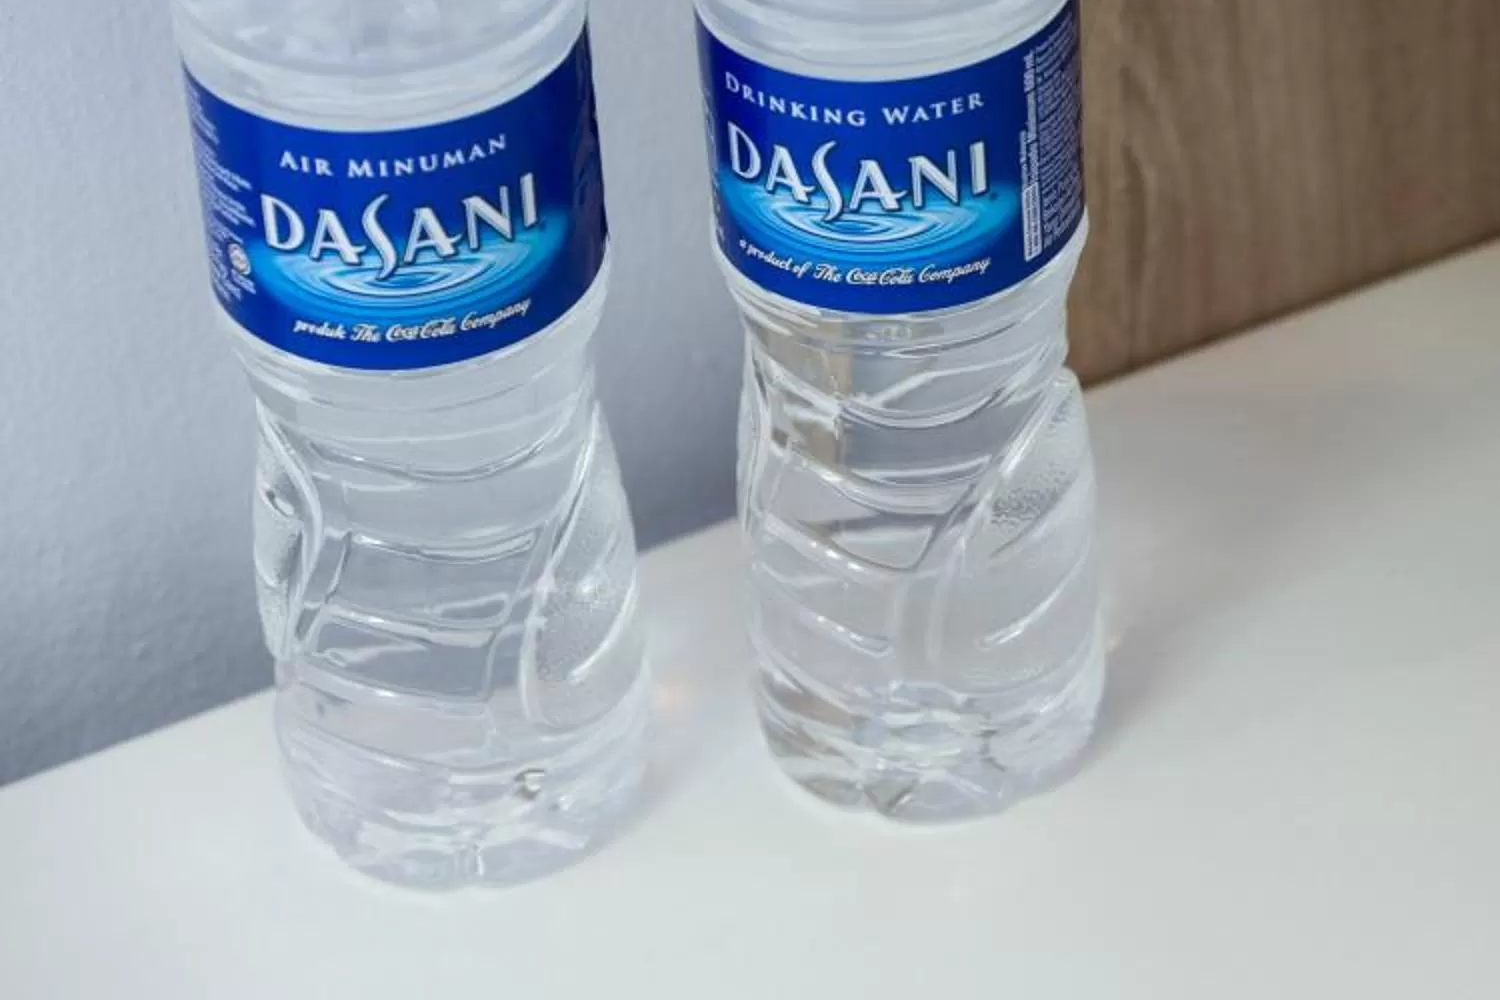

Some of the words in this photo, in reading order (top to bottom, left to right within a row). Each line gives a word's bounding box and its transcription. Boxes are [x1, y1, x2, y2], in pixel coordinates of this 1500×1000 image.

[725, 71, 867, 127] DRINKING
[882, 92, 985, 126] WATER
[280, 150, 334, 176] AIR
[347, 133, 507, 178] MINUMAN
[727, 121, 988, 223] DASANI
[259, 171, 538, 281] DASANI
[746, 244, 792, 272] product
[792, 261, 812, 278] of
[813, 263, 842, 283] The
[918, 257, 991, 284] Company
[294, 319, 347, 339] produk
[350, 323, 381, 343] The
[461, 299, 532, 331] Company
